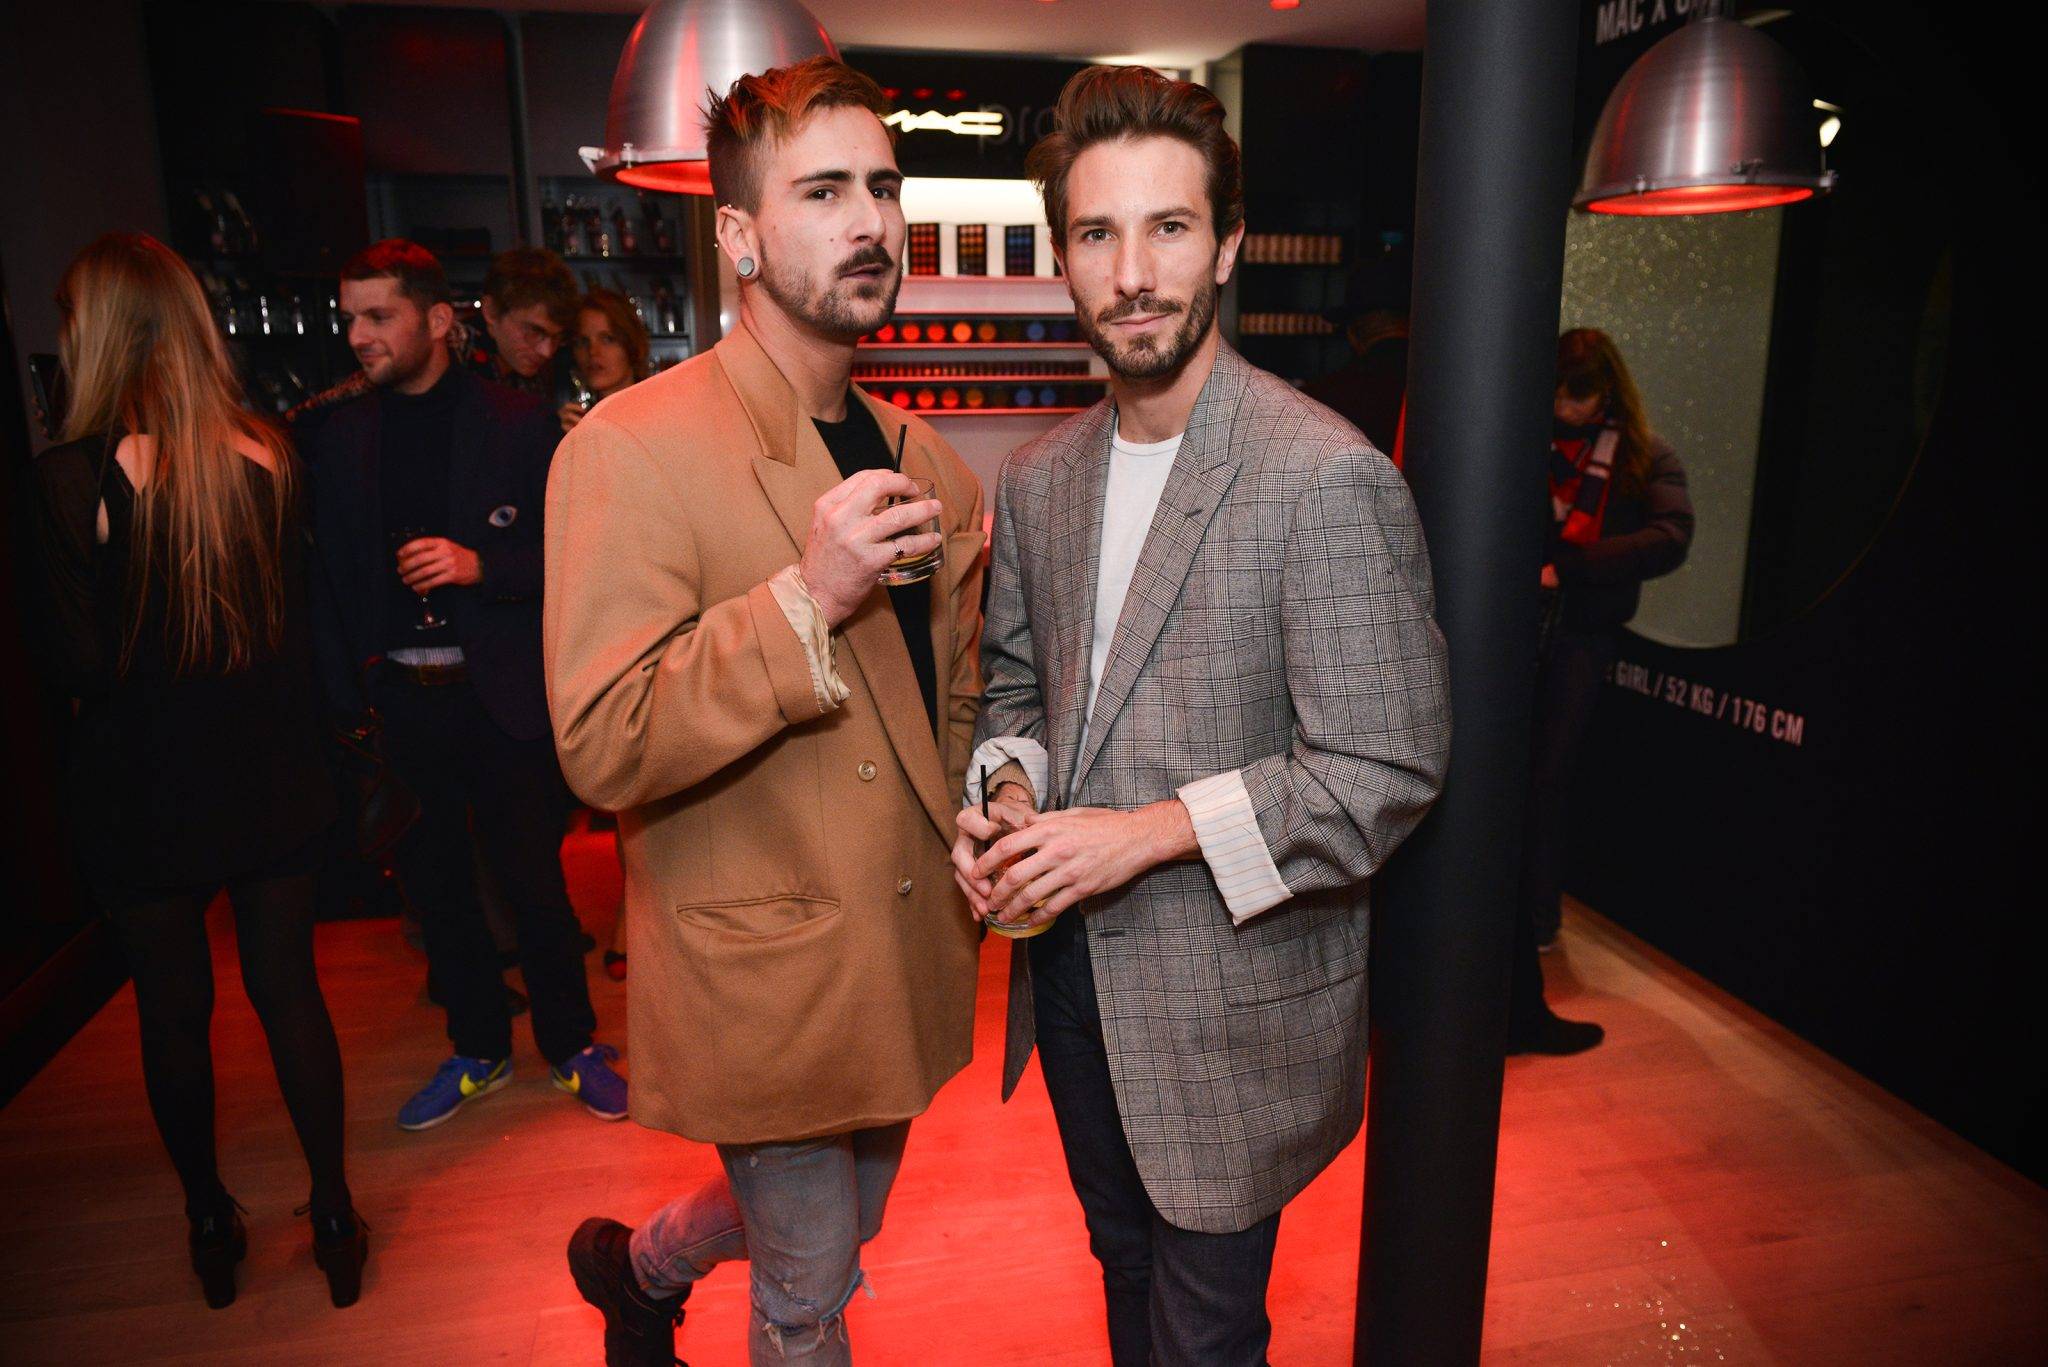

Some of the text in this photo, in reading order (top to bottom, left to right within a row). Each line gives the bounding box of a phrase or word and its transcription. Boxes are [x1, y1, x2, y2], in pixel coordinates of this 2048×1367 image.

[1595, 0, 1645, 46] MAC
[1616, 661, 1651, 695] GIRL
[1666, 675, 1687, 707] 52
[1691, 684, 1715, 716] KG
[1733, 697, 1767, 733] 176
[1772, 709, 1804, 746] CM
